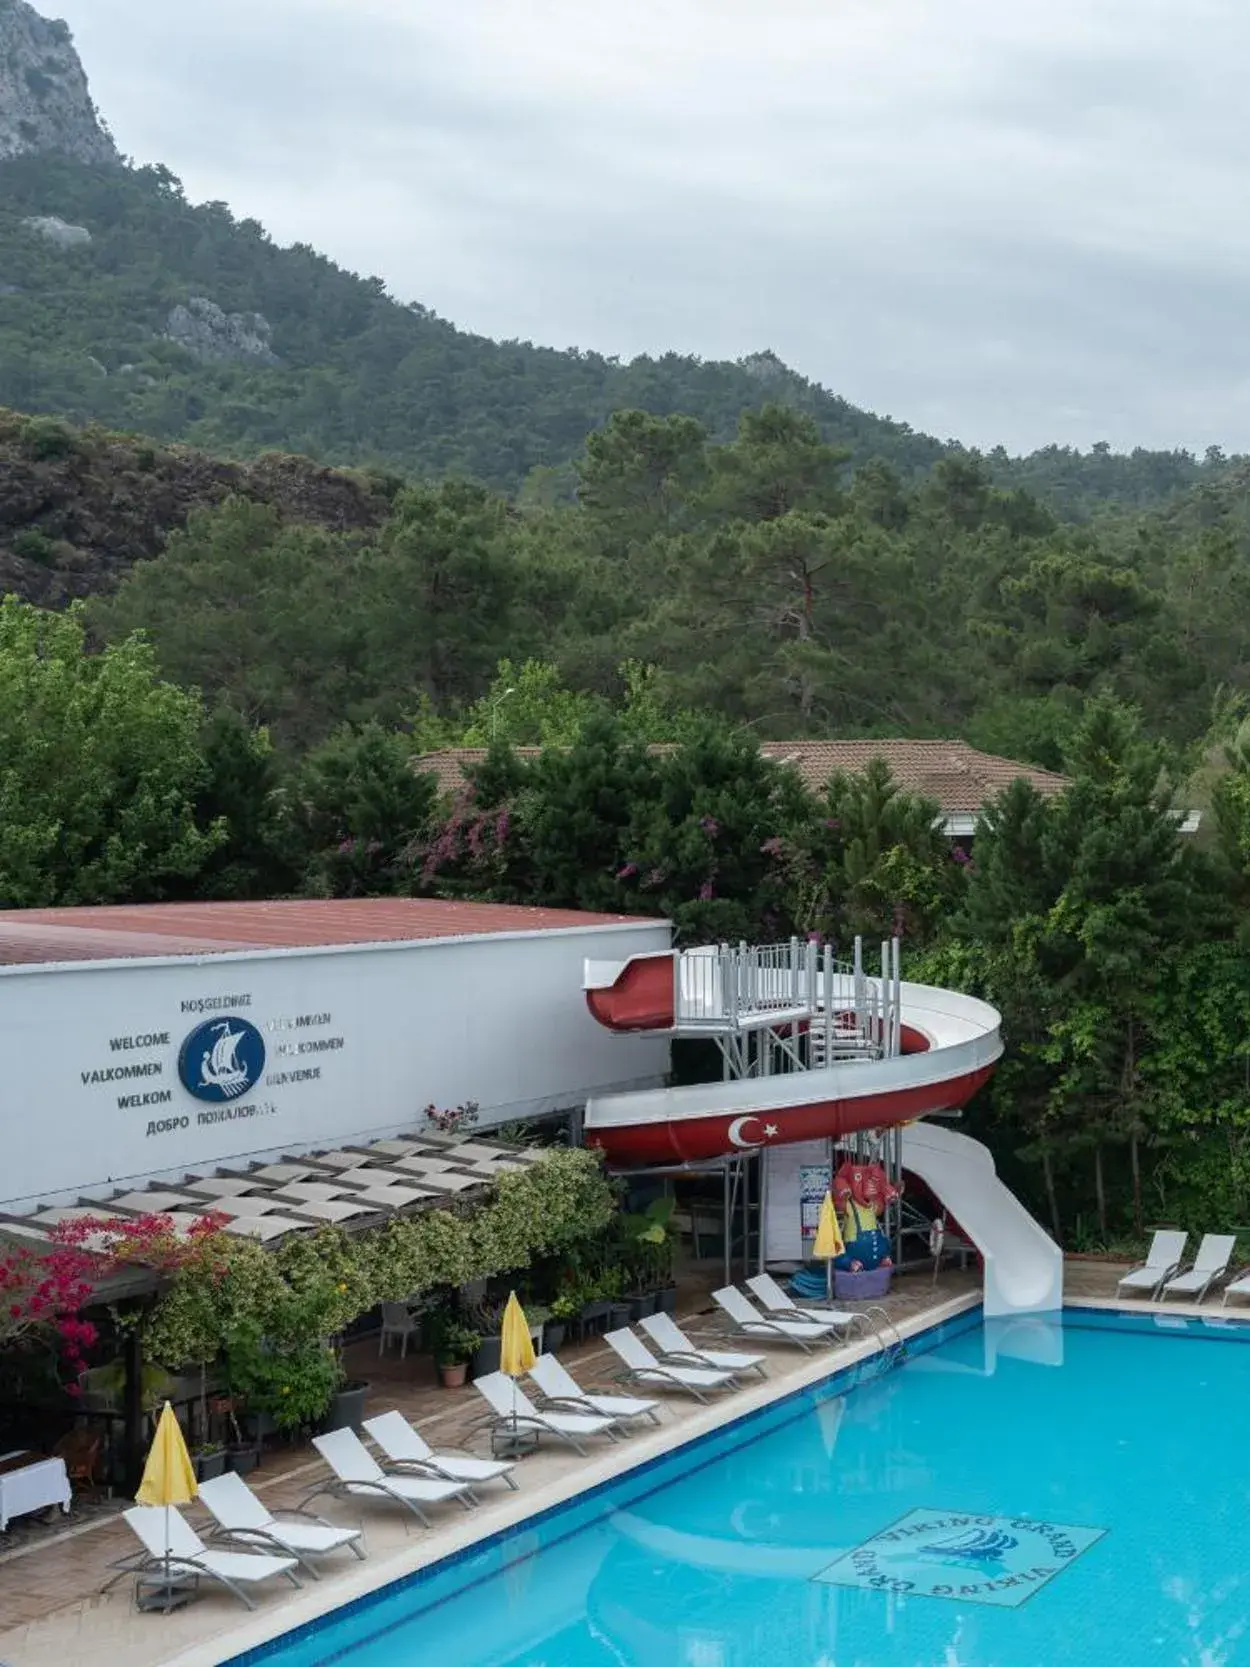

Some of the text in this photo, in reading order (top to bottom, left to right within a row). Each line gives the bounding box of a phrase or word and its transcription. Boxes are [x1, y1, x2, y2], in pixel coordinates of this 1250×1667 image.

[109, 1031, 171, 1052] WELCOME
[117, 1089, 172, 1110] WELKOM
[145, 1101, 279, 1137] ДОБРО ПОЖАЛОВ
[874, 1517, 994, 1543] VIKING
[1010, 1518, 1079, 1560] GRAND
[930, 1566, 1059, 1595] VIKING
